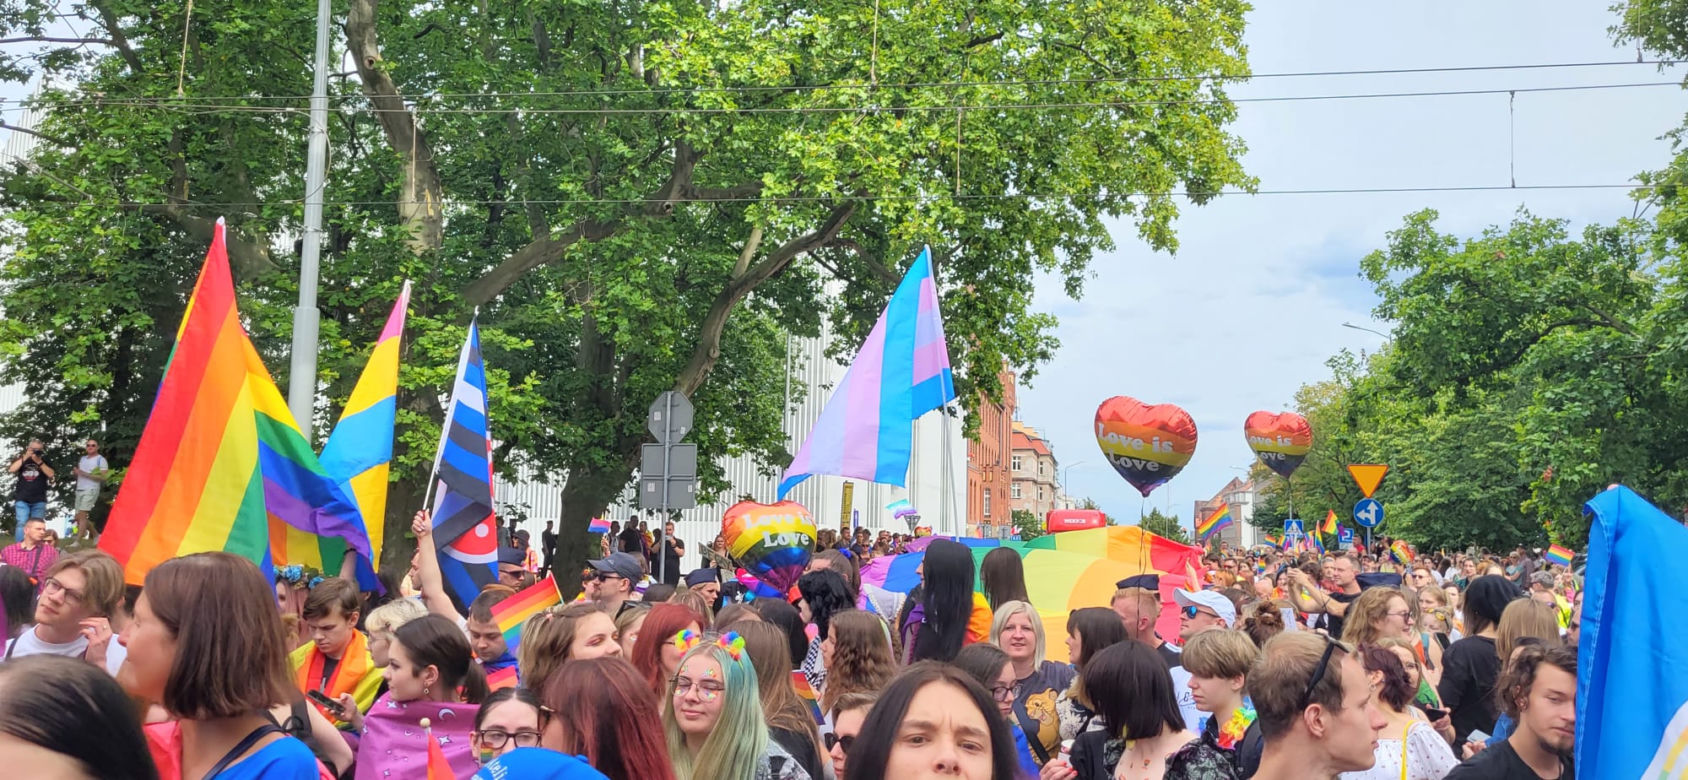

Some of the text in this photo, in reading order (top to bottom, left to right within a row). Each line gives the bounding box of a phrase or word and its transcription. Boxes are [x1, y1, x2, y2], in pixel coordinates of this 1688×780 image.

[1098, 422, 1174, 453] Love is
[1276, 434, 1292, 447] is
[1108, 448, 1160, 472] Love
[1260, 452, 1286, 460] ove
[742, 513, 793, 529] Love
[762, 531, 809, 547] Love
